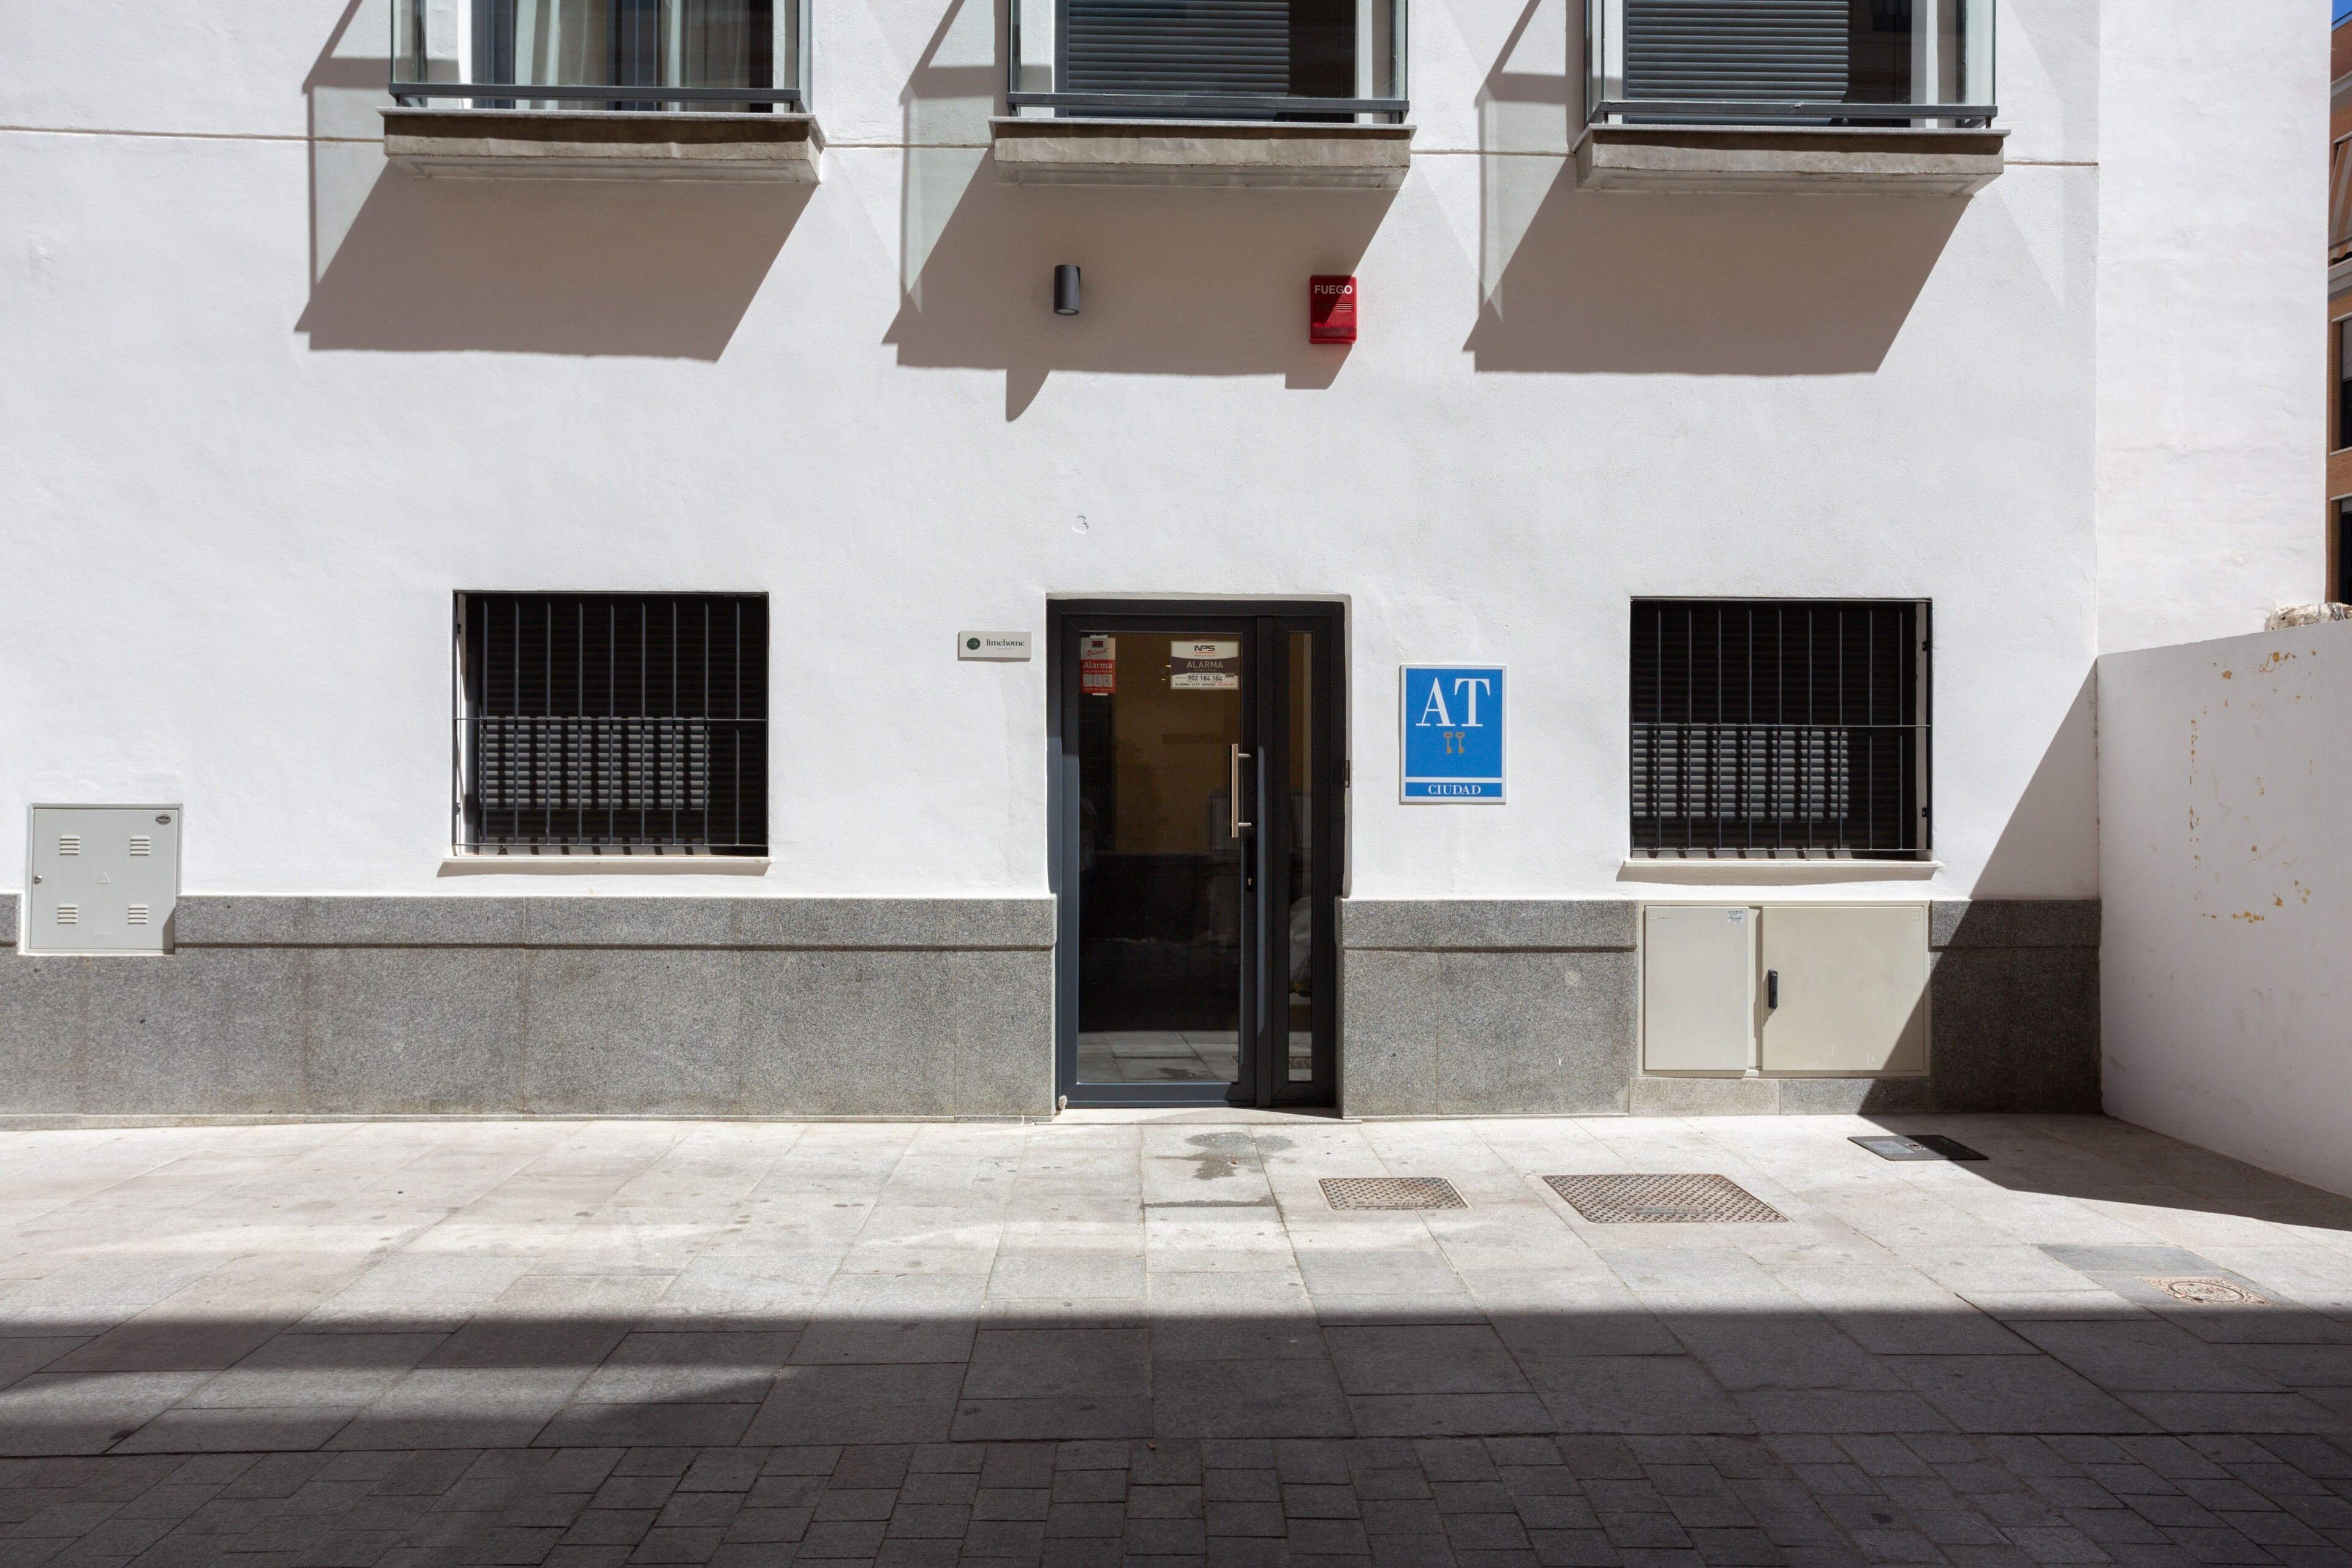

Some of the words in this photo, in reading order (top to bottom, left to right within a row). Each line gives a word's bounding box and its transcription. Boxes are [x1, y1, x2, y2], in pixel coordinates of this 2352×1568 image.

[1314, 285, 1352, 294] FUEGO
[1415, 677, 1490, 727] AT
[1428, 785, 1481, 794] CIUDAD
